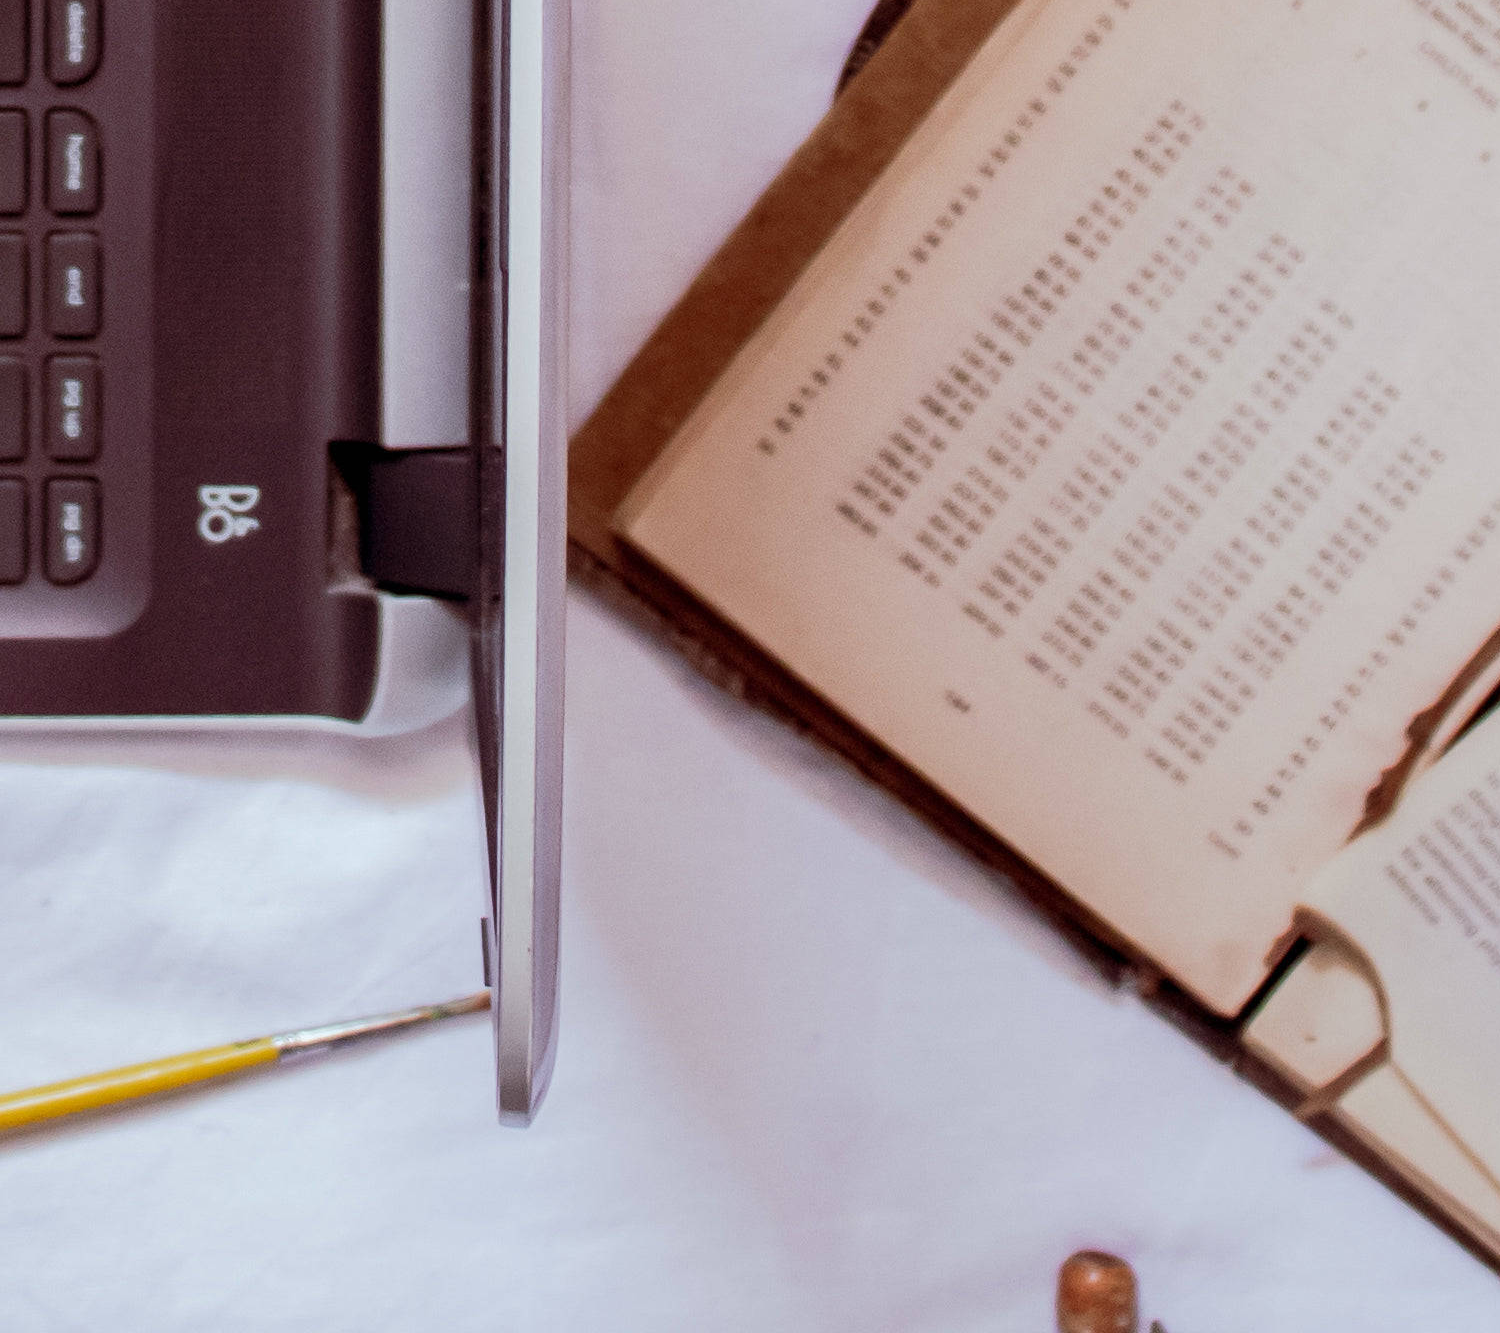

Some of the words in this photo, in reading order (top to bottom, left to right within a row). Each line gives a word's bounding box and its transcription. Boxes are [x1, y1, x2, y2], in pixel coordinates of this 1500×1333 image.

[65, 0, 86, 65] delete
[64, 133, 84, 191] home
[64, 265, 84, 307] end
[60, 378, 82, 409] pg
[61, 409, 81, 439] up
[60, 501, 82, 533] pg
[63, 533, 84, 563] dn
